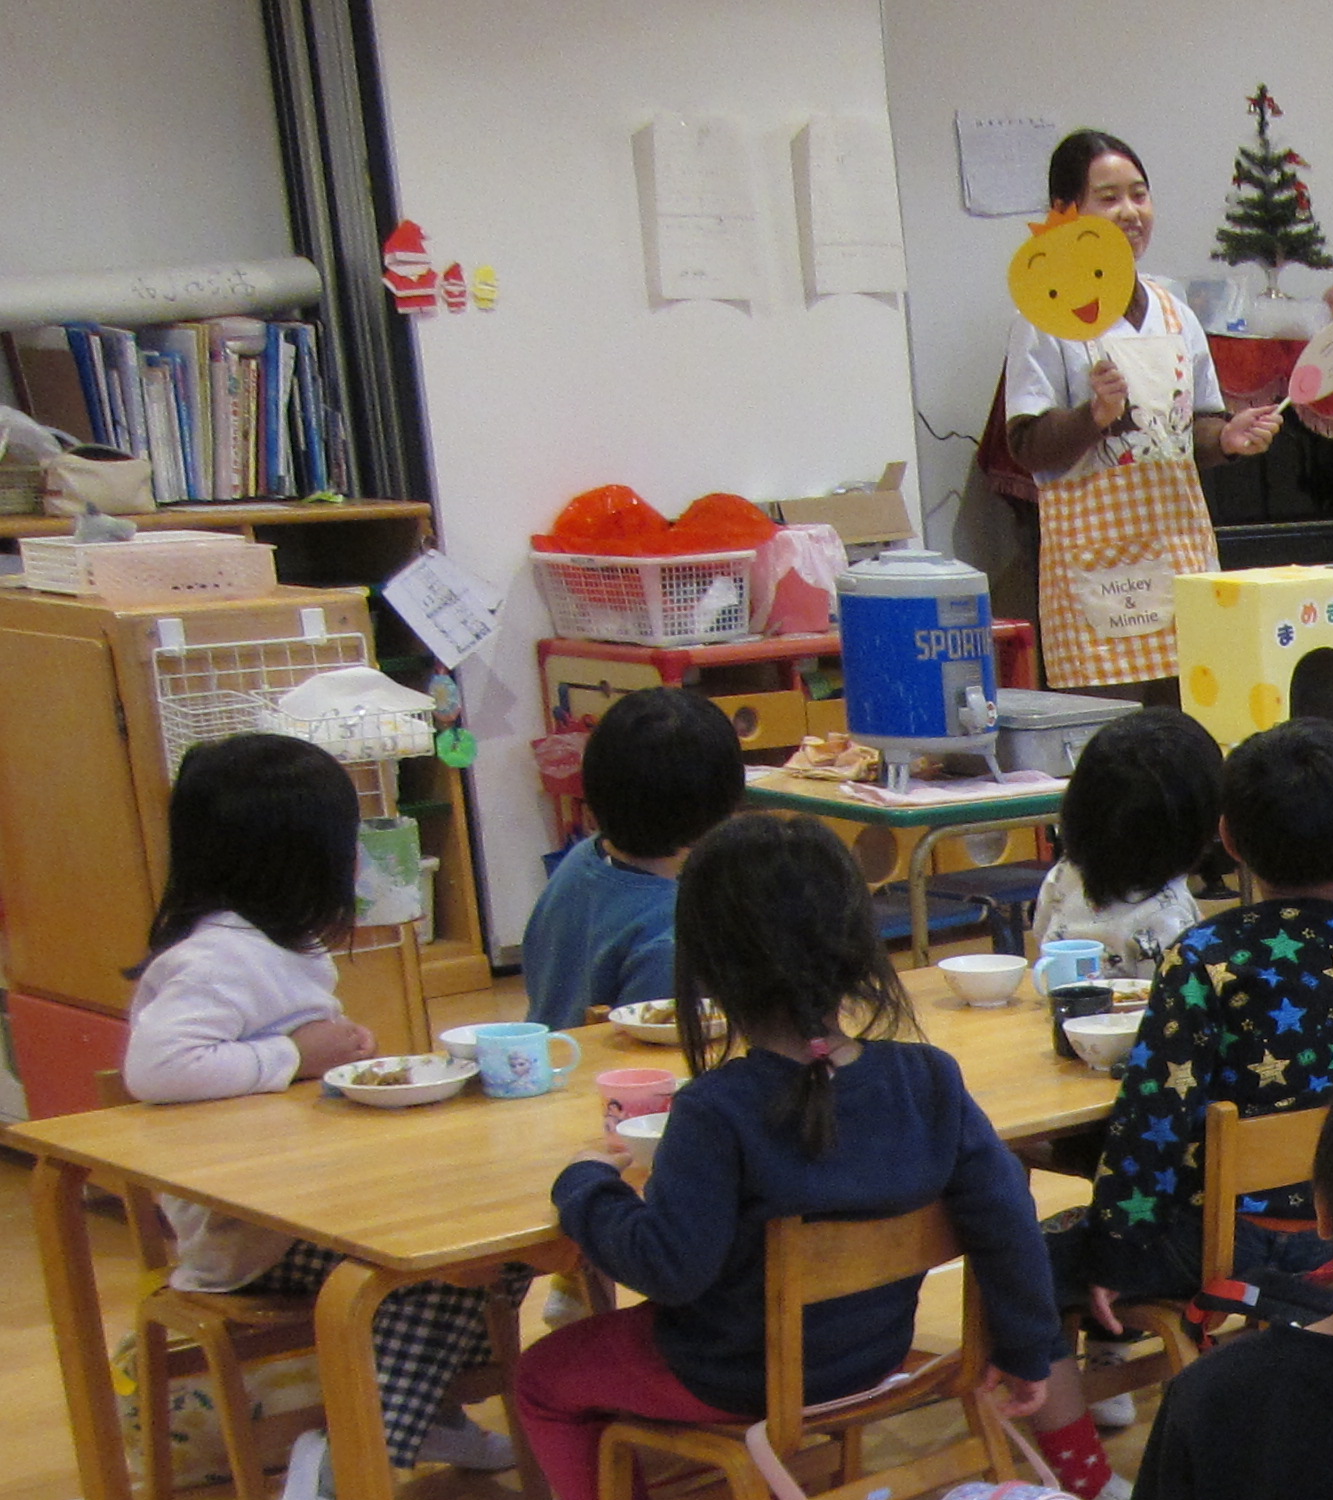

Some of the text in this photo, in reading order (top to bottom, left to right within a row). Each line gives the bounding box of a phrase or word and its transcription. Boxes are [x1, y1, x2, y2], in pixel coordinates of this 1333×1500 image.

[1101, 578, 1152, 596] Mickey
[1125, 596, 1136, 609] &
[1109, 610, 1158, 628] Minnie
